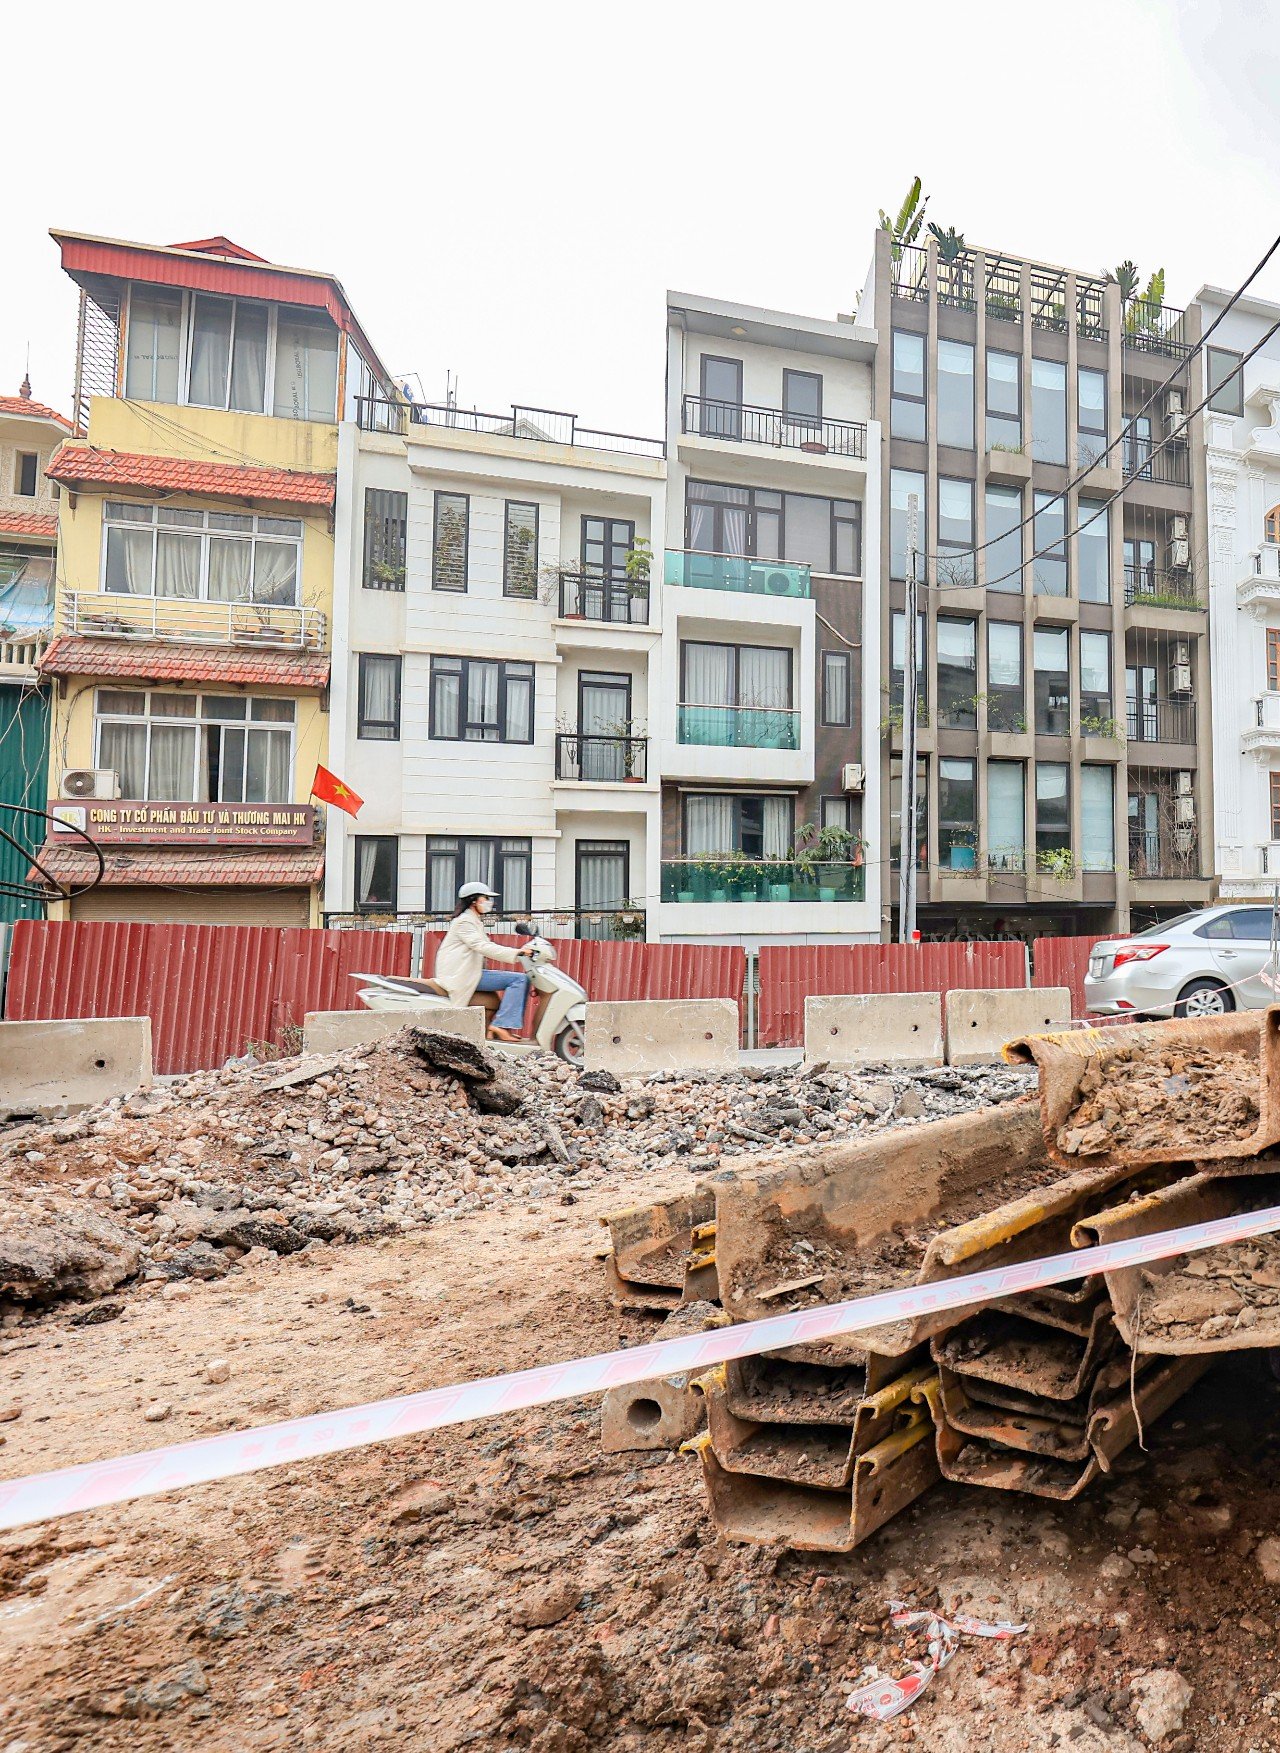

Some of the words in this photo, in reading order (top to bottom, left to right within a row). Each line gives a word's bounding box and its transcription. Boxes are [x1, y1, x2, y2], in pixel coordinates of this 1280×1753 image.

[120, 809, 132, 823] TY
[134, 805, 148, 823] CỔ
[202, 809, 216, 824] TƯ
[218, 808, 230, 824] VÀ
[232, 810, 270, 825] THƯƠNG
[293, 812, 306, 826] HK
[98, 825, 112, 833] HK
[120, 826, 168, 834] Investment
[169, 826, 186, 834] and
[235, 827, 259, 835] Stock
[260, 827, 298, 836] Company
